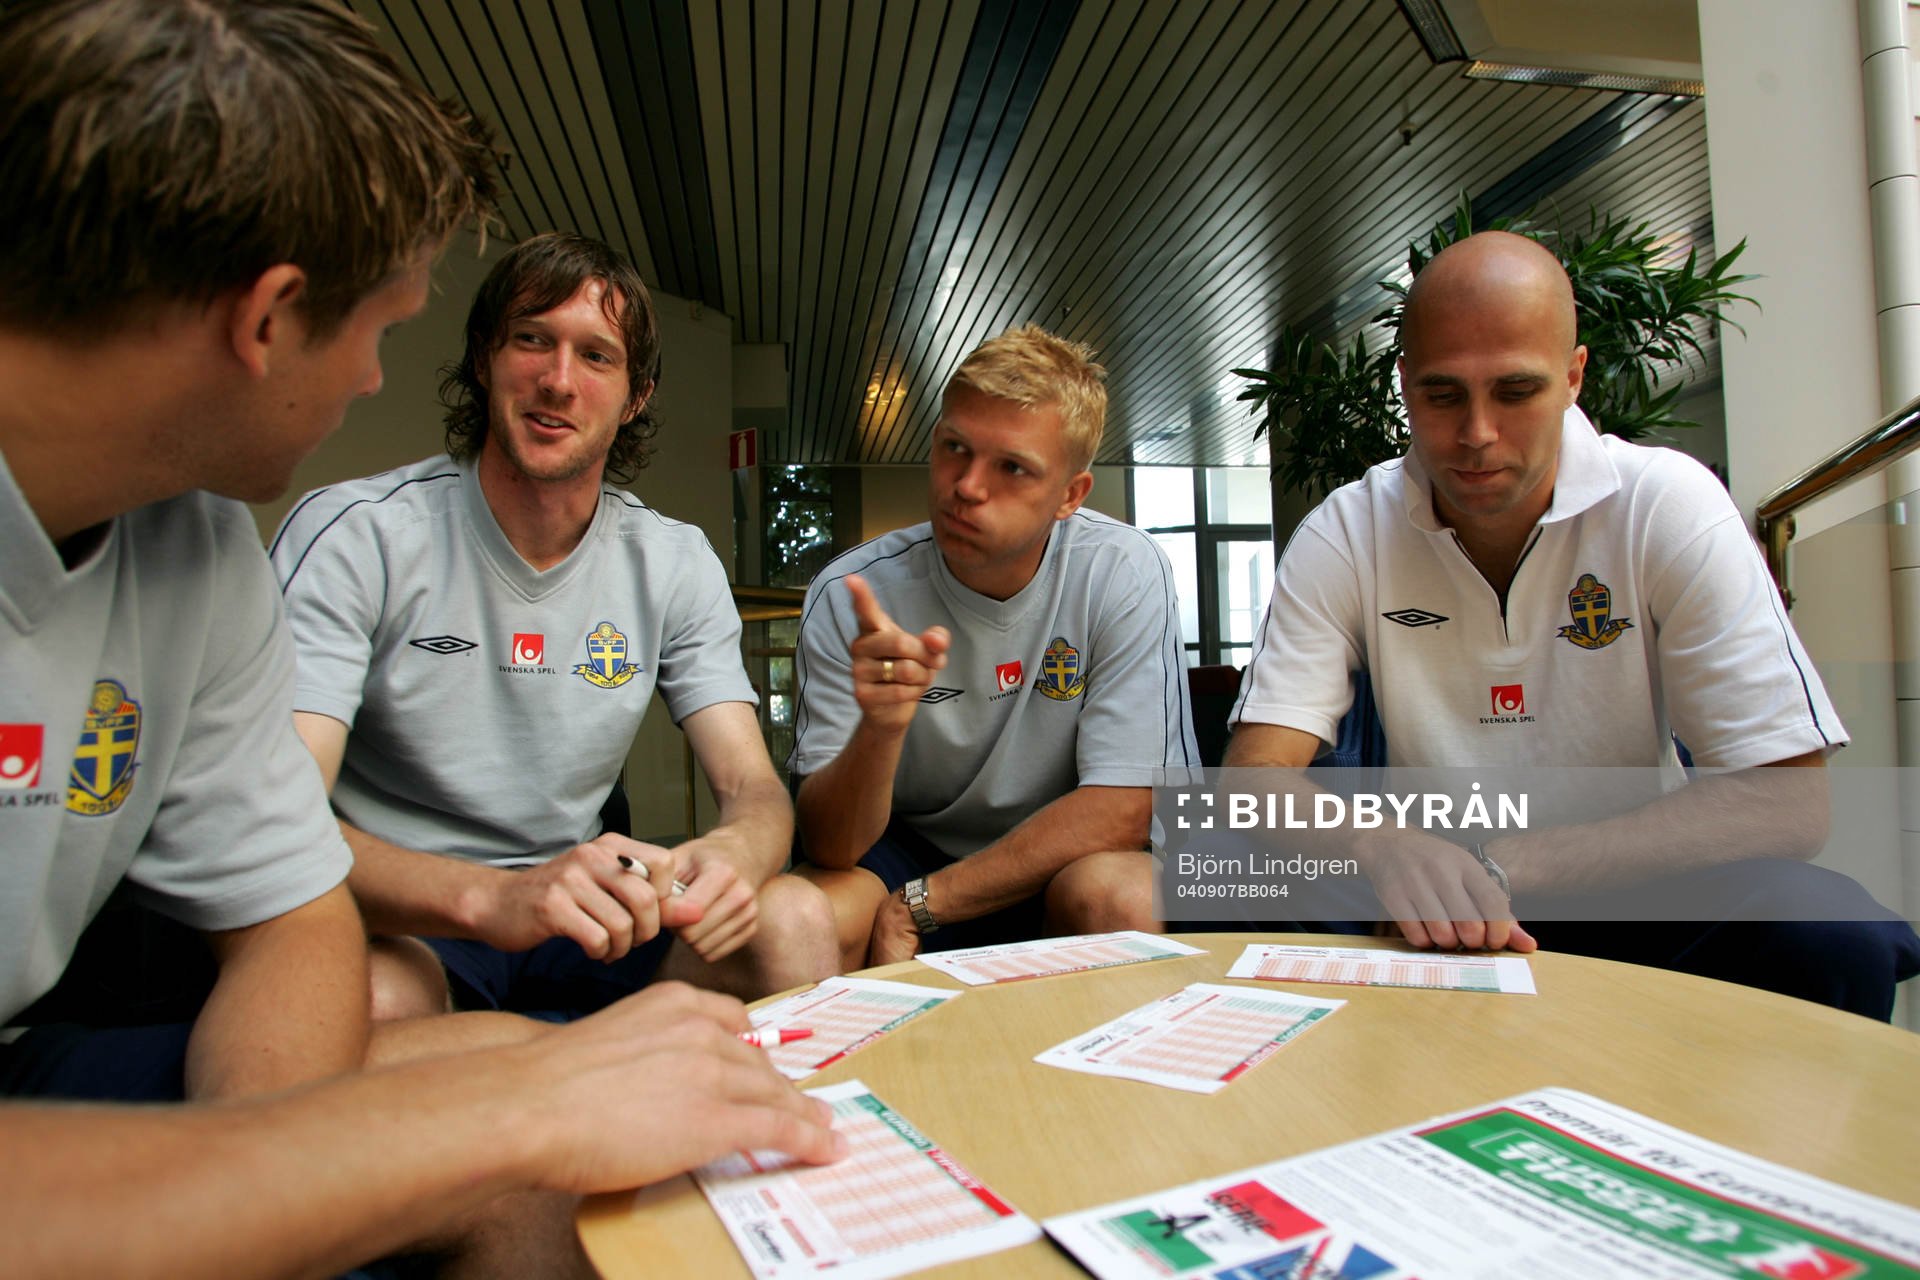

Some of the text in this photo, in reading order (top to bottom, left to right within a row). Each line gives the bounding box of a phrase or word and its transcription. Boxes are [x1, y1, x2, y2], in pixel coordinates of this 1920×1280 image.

[498, 665, 556, 674] SVENSKA SPEL
[1479, 715, 1536, 724] SVENSKA SPEL
[1505, 1141, 1741, 1244] EUROPA
